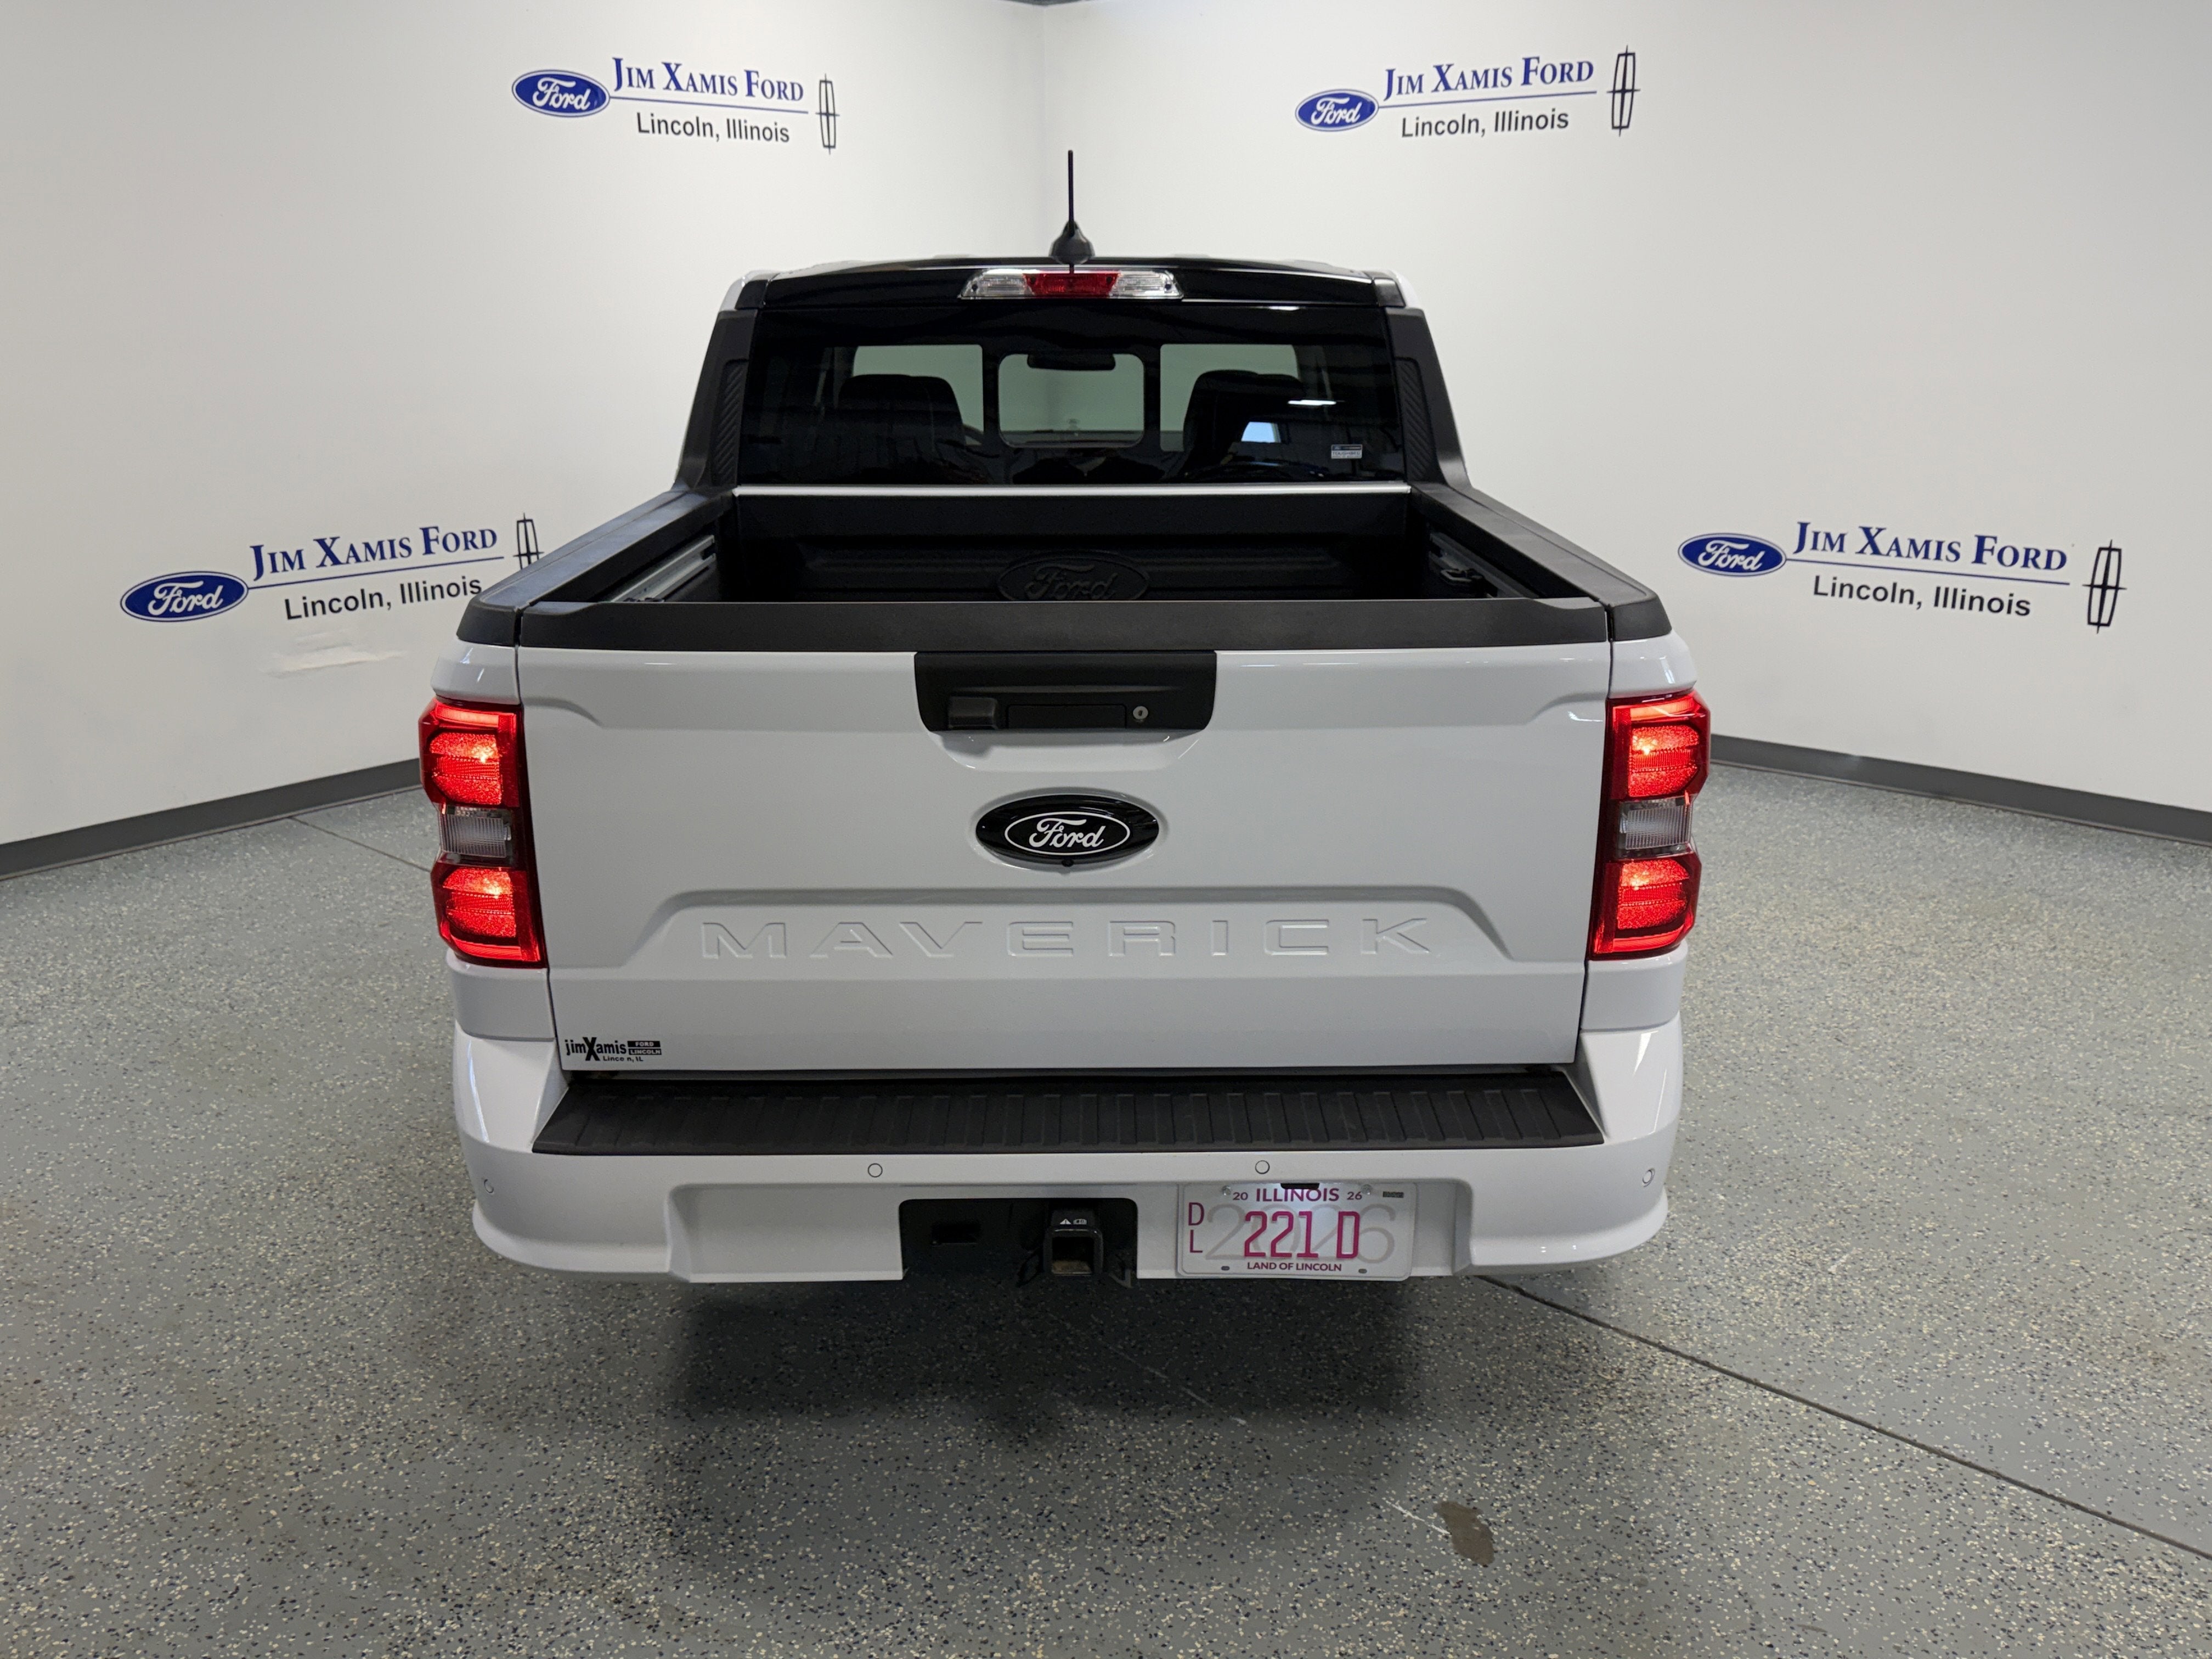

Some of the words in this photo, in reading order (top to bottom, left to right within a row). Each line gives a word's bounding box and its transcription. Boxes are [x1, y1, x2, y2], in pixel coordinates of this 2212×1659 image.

[532, 77, 591, 110] Ford
[612, 57, 655, 92] JIM
[661, 61, 738, 96] XAMIS
[744, 69, 804, 101] FORD
[1384, 68, 1424, 101] JIM
[1431, 63, 1513, 92] XAMIS
[1521, 56, 1594, 86] FORD
[636, 112, 720, 141] Lincoln,
[726, 118, 789, 143] Illinois
[1310, 95, 1361, 125] Ford
[1402, 114, 1486, 137] Lincoln,
[1494, 108, 1569, 132] Illinois
[250, 544, 305, 581] JIM
[313, 536, 413, 568] XAMIS
[419, 526, 497, 556] FORD
[1697, 538, 1763, 572] Ford
[1792, 522, 1847, 554] JIM
[1855, 526, 1961, 562] XAMIS
[1971, 534, 2067, 571] FORD
[147, 580, 223, 616] Ford
[284, 588, 391, 620] Lincoln,
[400, 575, 482, 605] Illinois
[1025, 563, 1118, 600] Ford
[1813, 575, 1922, 610] Lincoln,
[1933, 586, 2031, 617] Illinois
[1029, 817, 1106, 848] Ford
[701, 918, 1430, 959] MAVERICK
[1233, 1192, 1249, 1200] 20
[1256, 1188, 1340, 1202] ILLINOIS
[1347, 1191, 1363, 1200] 26
[1247, 1262, 1277, 1270] LAND
[1279, 1262, 1294, 1271] OF
[1296, 1262, 1342, 1272] LINCOLN
